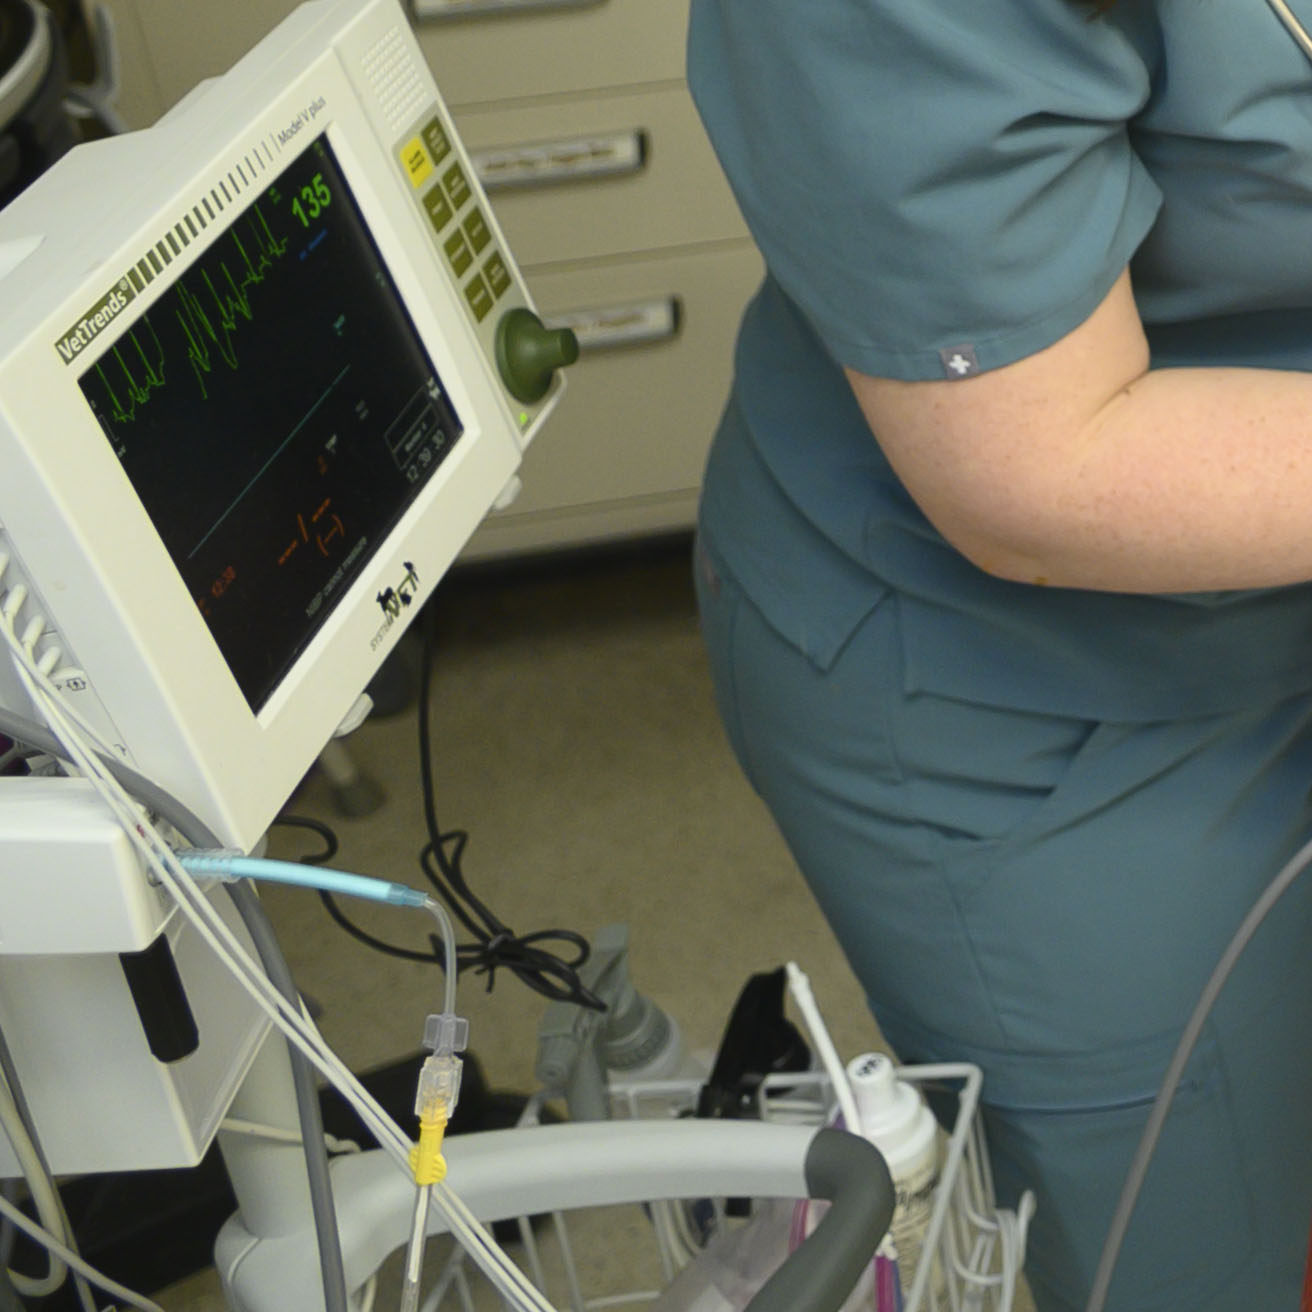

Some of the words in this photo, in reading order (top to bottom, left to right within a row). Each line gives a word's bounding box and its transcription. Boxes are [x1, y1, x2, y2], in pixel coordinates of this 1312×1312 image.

[277, 114, 304, 146] Model
[309, 96, 326, 120] plus
[291, 172, 331, 228] 135
